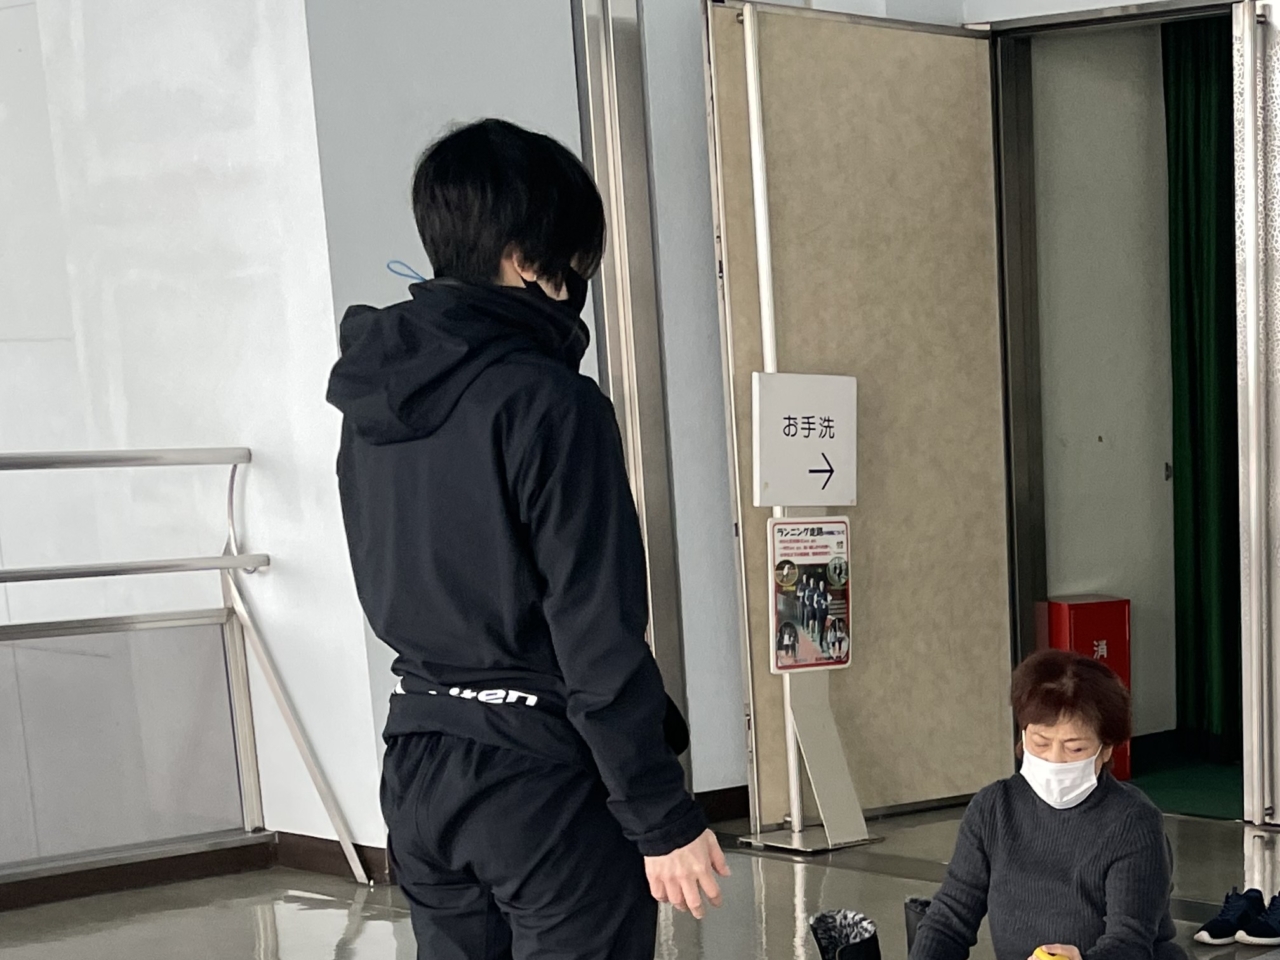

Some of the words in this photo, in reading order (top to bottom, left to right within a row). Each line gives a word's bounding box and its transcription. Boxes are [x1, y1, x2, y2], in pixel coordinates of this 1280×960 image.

[783, 415, 835, 439] お手洗
[1093, 640, 1107, 659] 消
